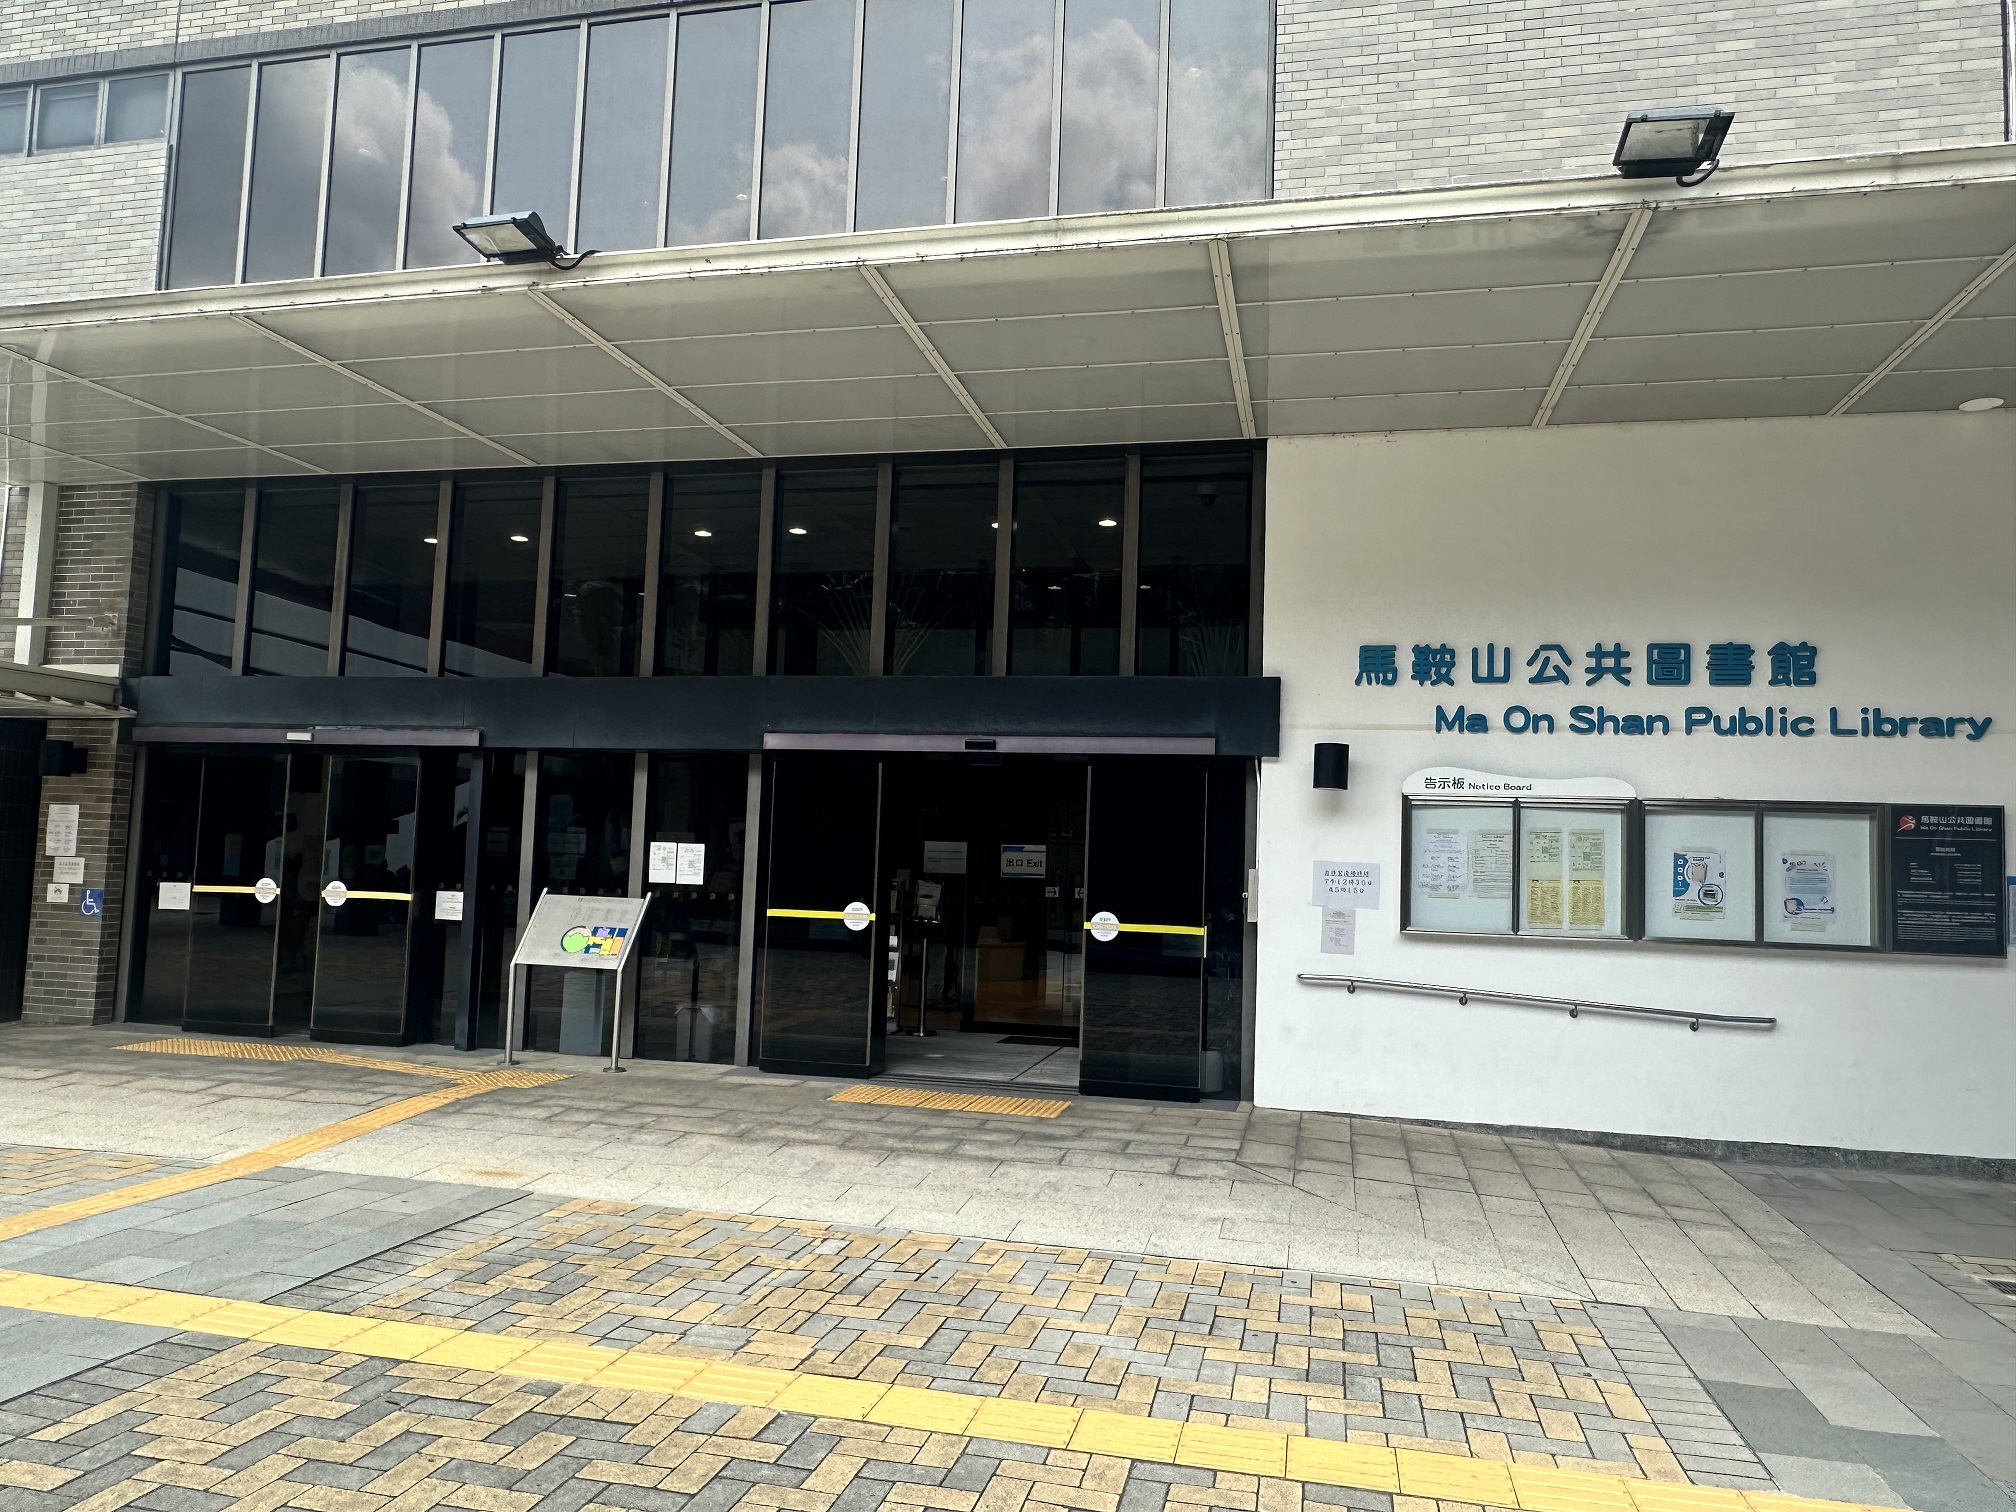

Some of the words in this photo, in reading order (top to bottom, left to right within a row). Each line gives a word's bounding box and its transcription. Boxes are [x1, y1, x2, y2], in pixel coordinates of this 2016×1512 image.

[1354, 641, 1818, 687] 馬鞍山公共圖書館
[1435, 705, 1488, 735] Ma
[1503, 705, 1554, 735] On
[1568, 705, 1670, 736] Shan
[1685, 706, 1815, 737] Public
[1829, 707, 1993, 741] Library
[1424, 776, 1465, 790] 告示板
[1468, 782, 1501, 791] Notice
[1503, 783, 1532, 791] Board
[1006, 858, 1023, 867] 出口
[1026, 859, 1043, 868] Exit
